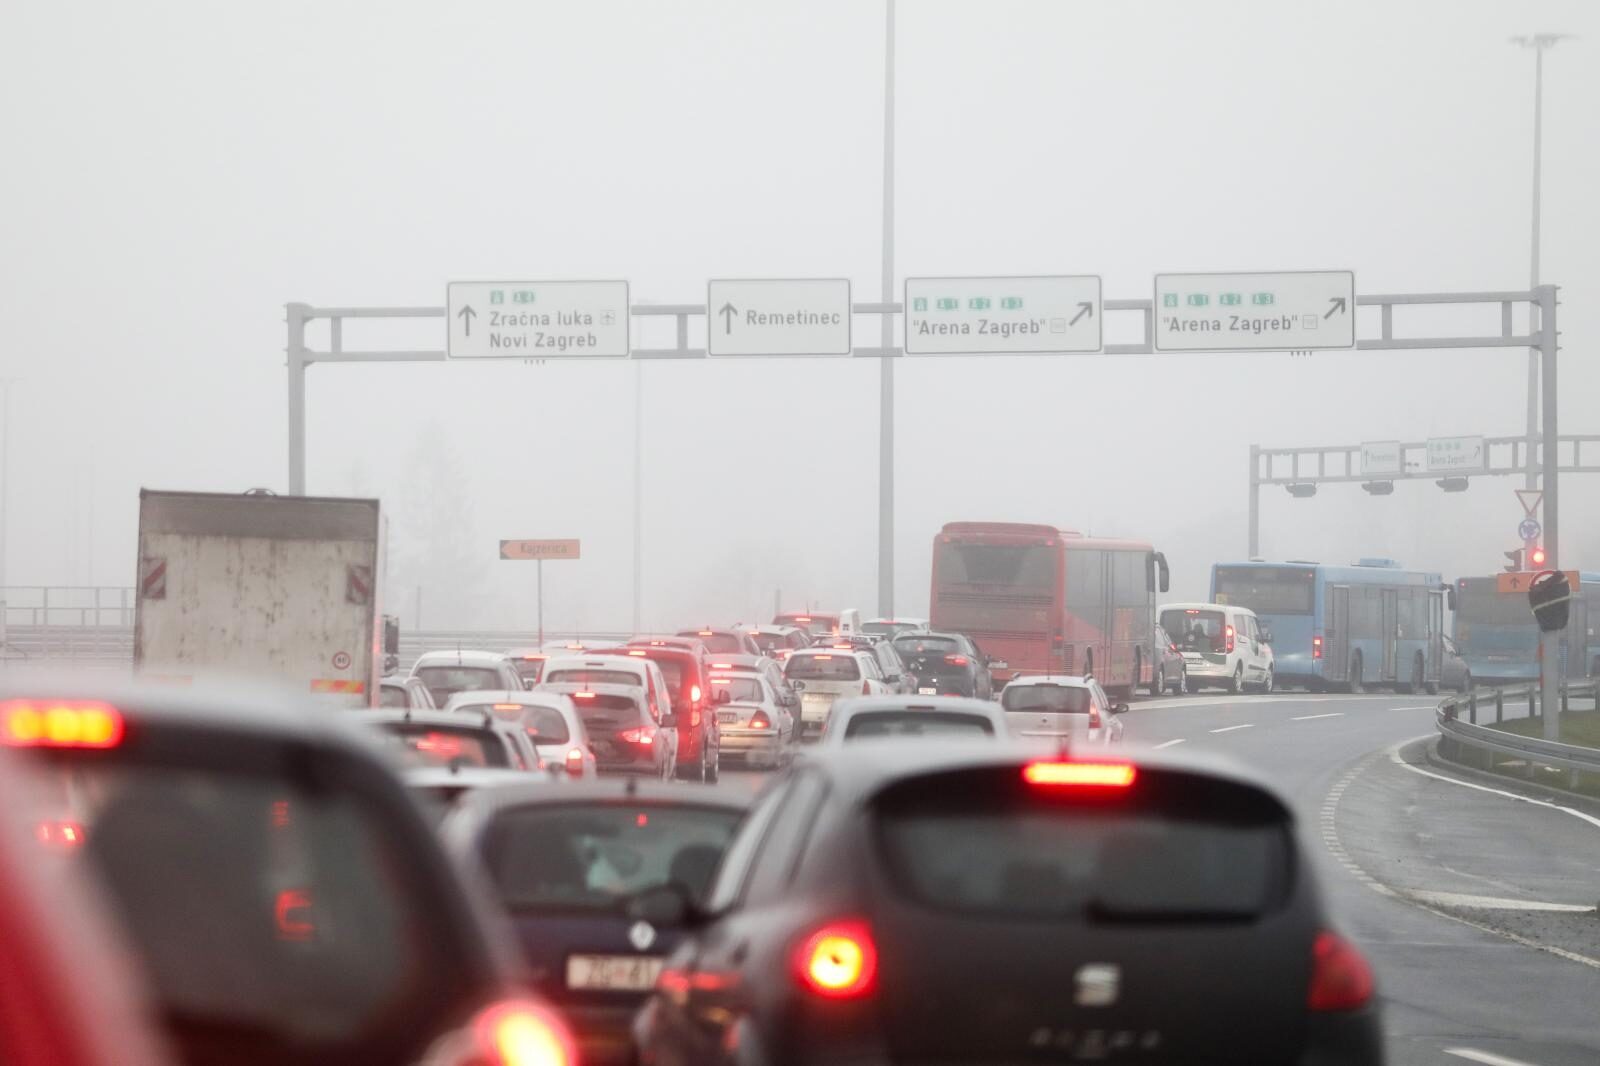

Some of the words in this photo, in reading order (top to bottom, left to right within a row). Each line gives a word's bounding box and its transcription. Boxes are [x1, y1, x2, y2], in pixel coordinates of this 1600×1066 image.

[489, 310, 550, 326] Zračna
[557, 310, 593, 326] luka
[746, 309, 840, 325] Remetinec
[1163, 316, 1221, 332] "Arena
[1229, 315, 1298, 334] Zagreb"
[913, 319, 971, 335] "Arena
[977, 319, 1046, 338] Zagreb"
[489, 333, 527, 348] Novi
[535, 332, 597, 351] Zagreb
